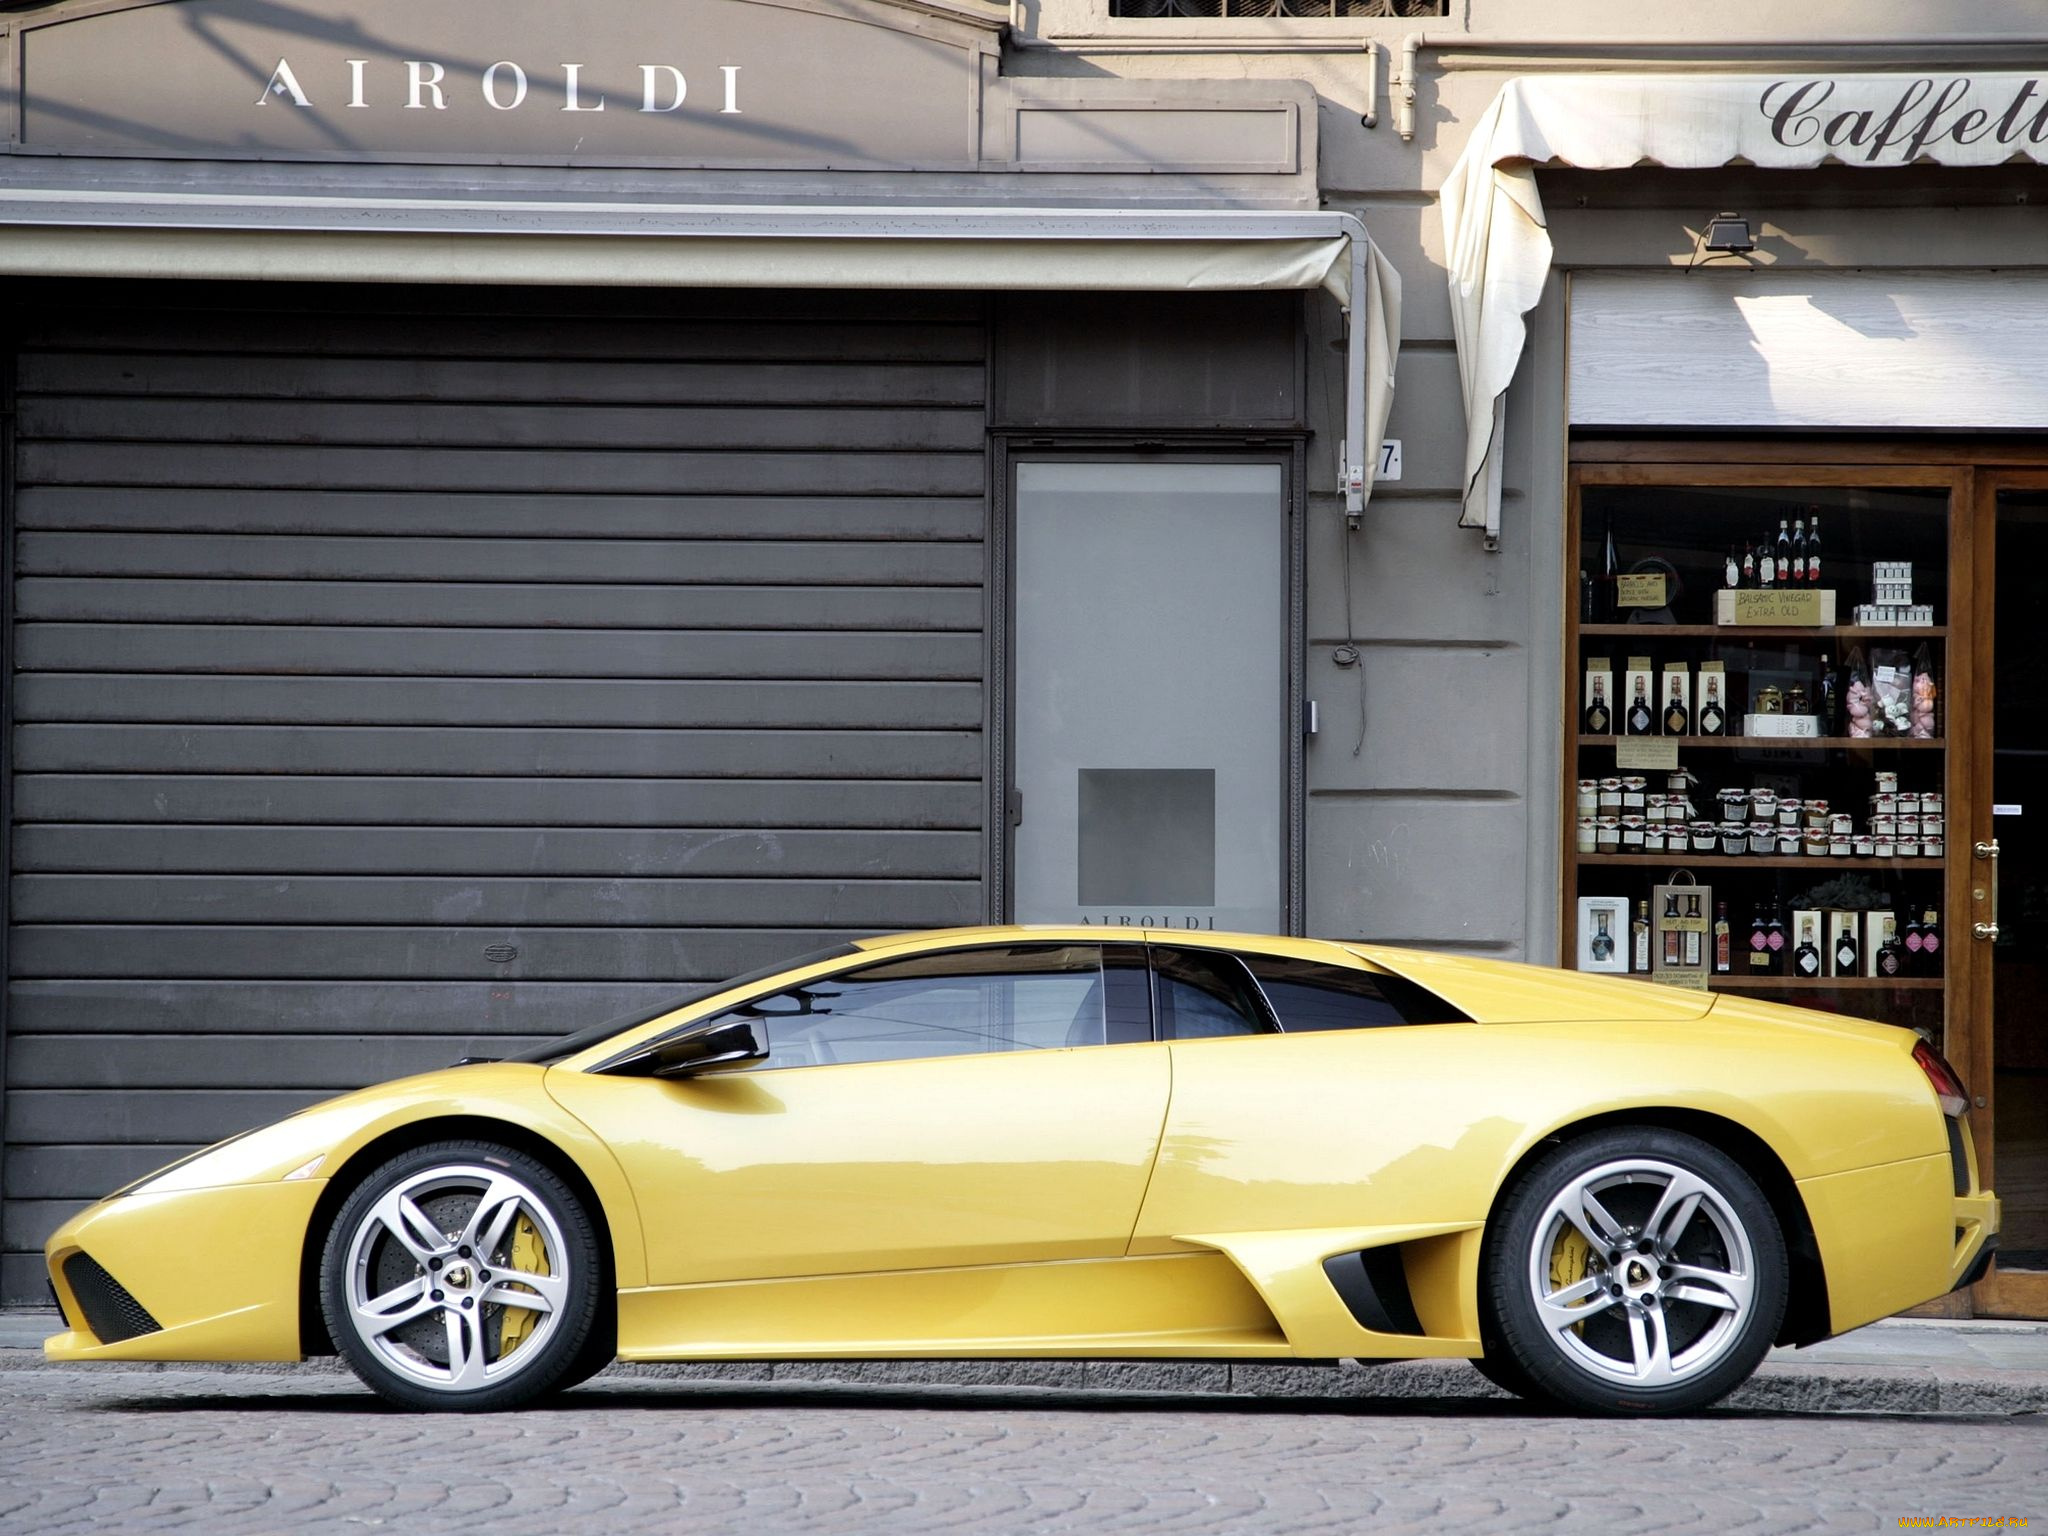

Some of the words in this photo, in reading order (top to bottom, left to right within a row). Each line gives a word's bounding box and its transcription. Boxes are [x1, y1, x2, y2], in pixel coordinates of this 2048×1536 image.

[256, 57, 743, 114] AIROLDI
[1781, 605, 1799, 616] OLD
[1080, 915, 1216, 930] AIROLDI
